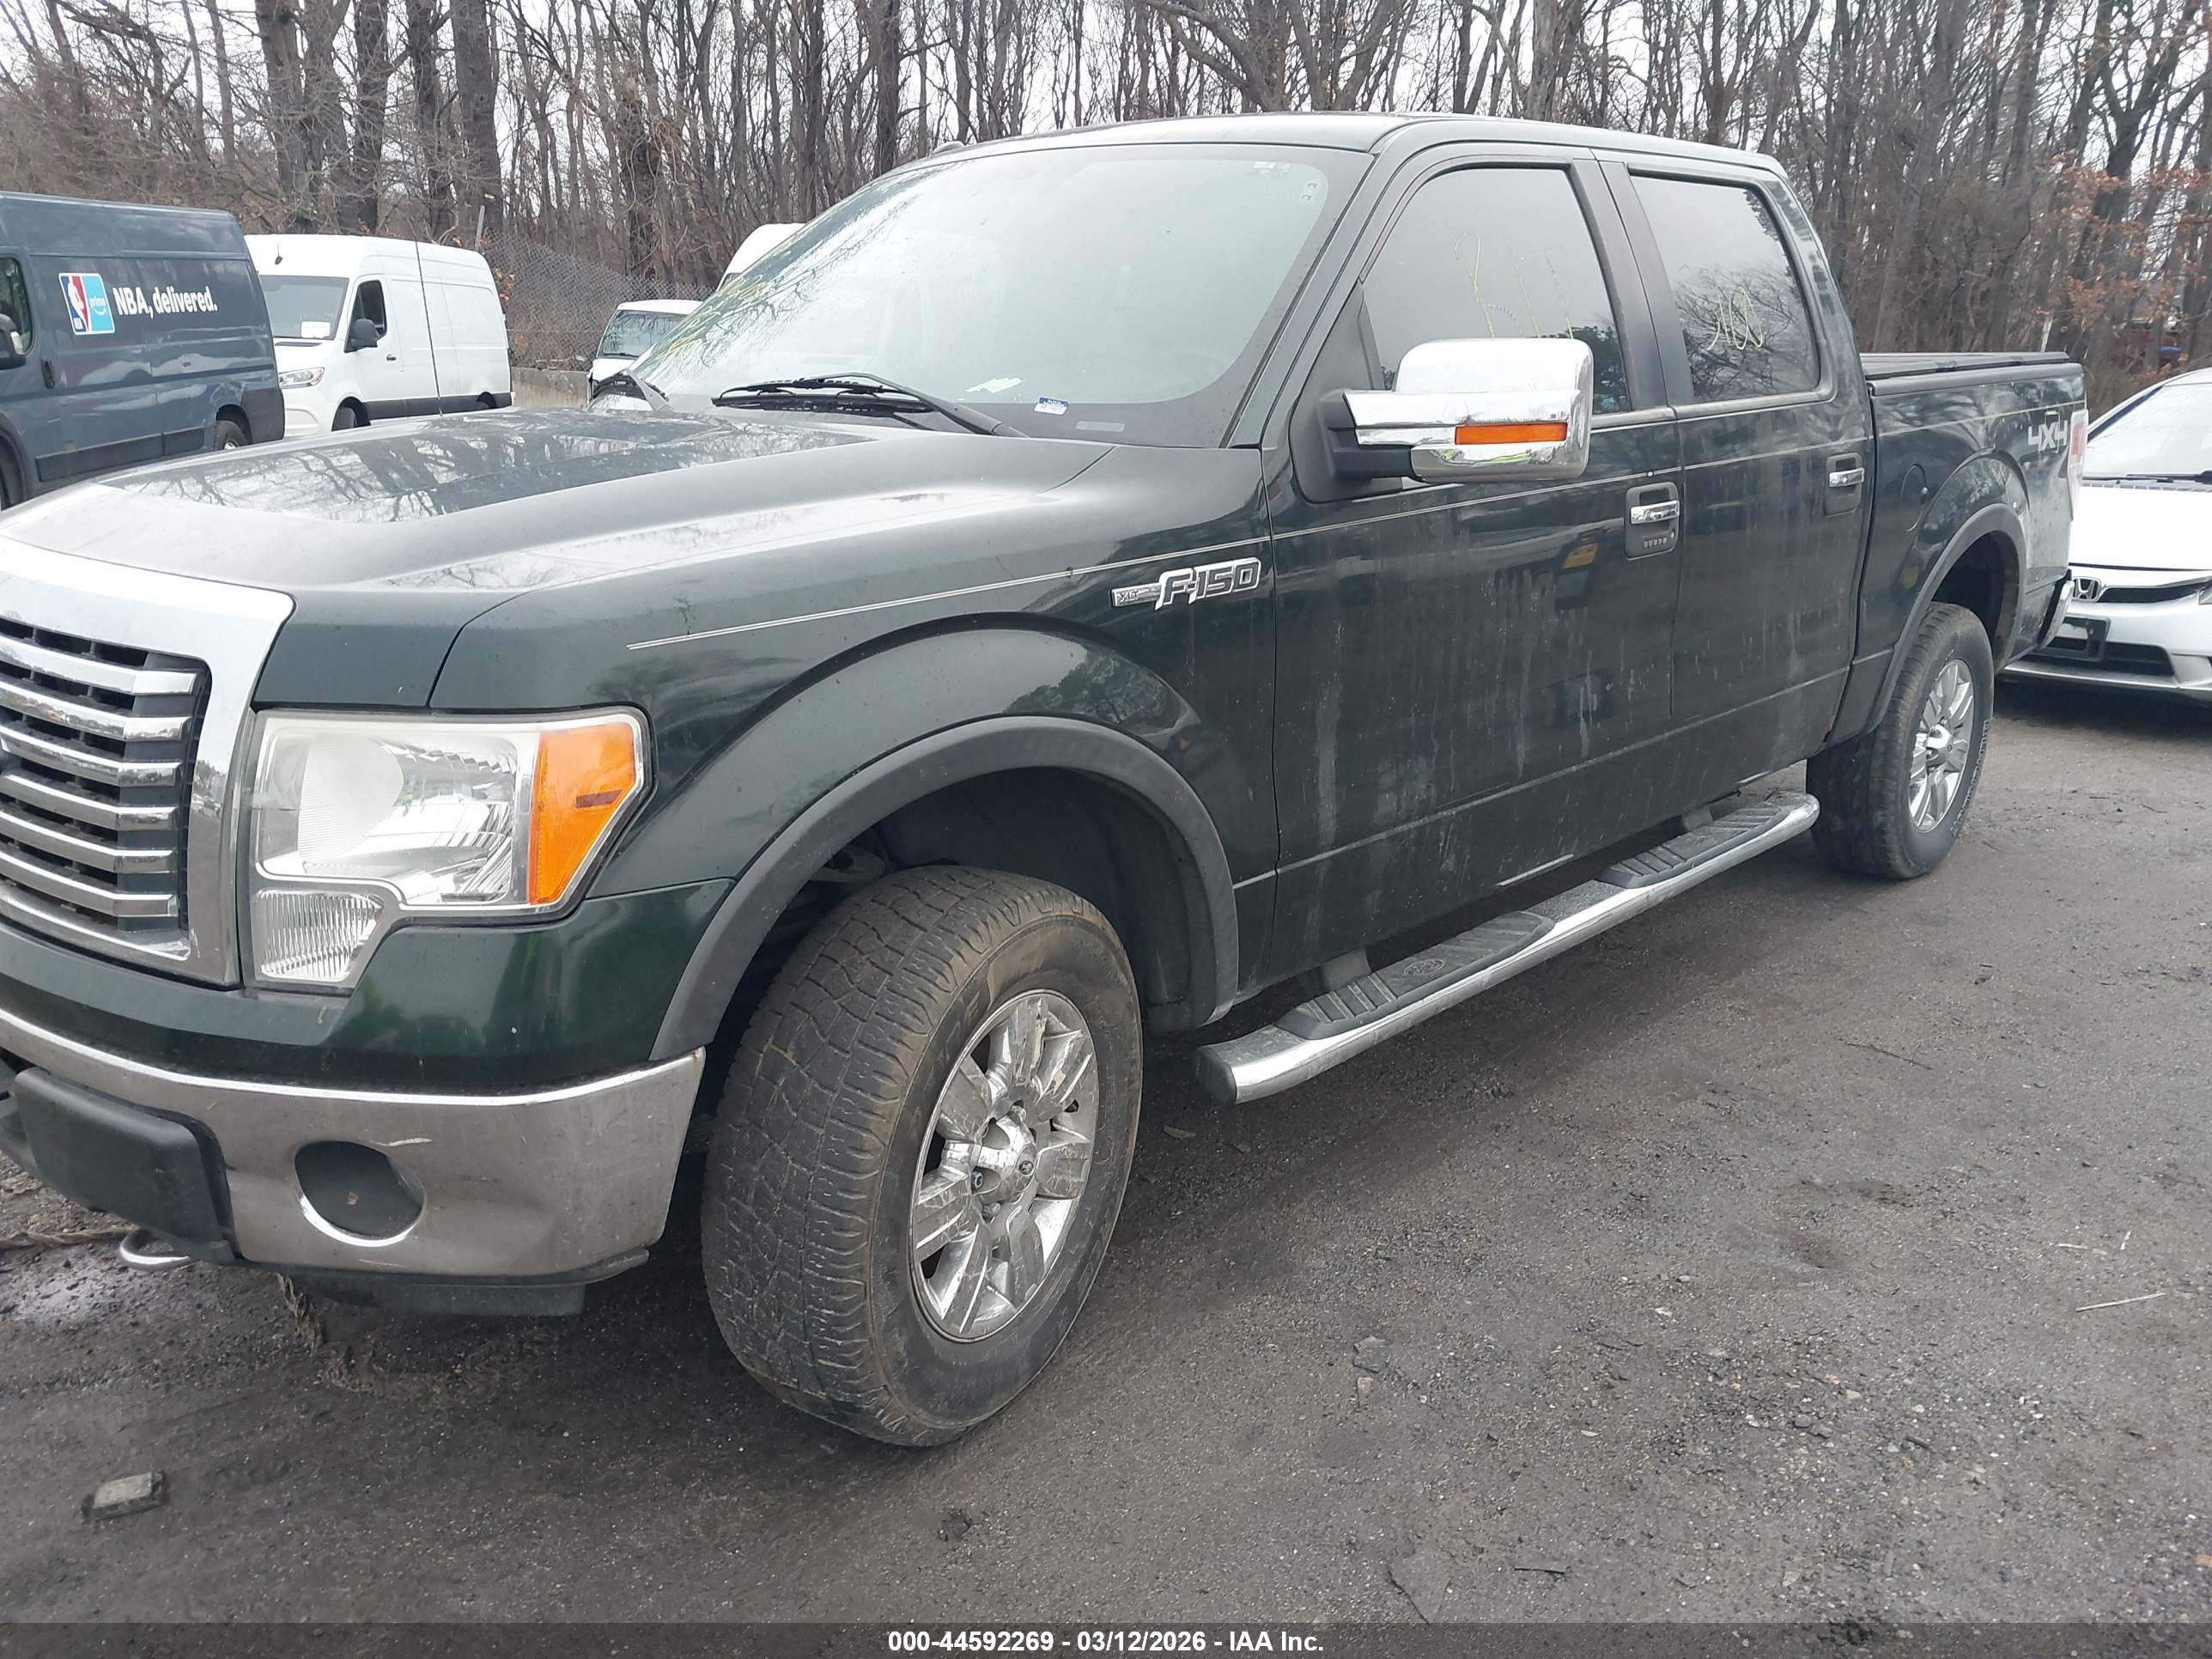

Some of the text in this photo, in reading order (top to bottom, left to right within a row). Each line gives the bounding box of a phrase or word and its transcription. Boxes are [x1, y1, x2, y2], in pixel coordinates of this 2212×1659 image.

[112, 286, 218, 319] NBA, delivered.
[1118, 557, 1262, 611] XLT F-150
